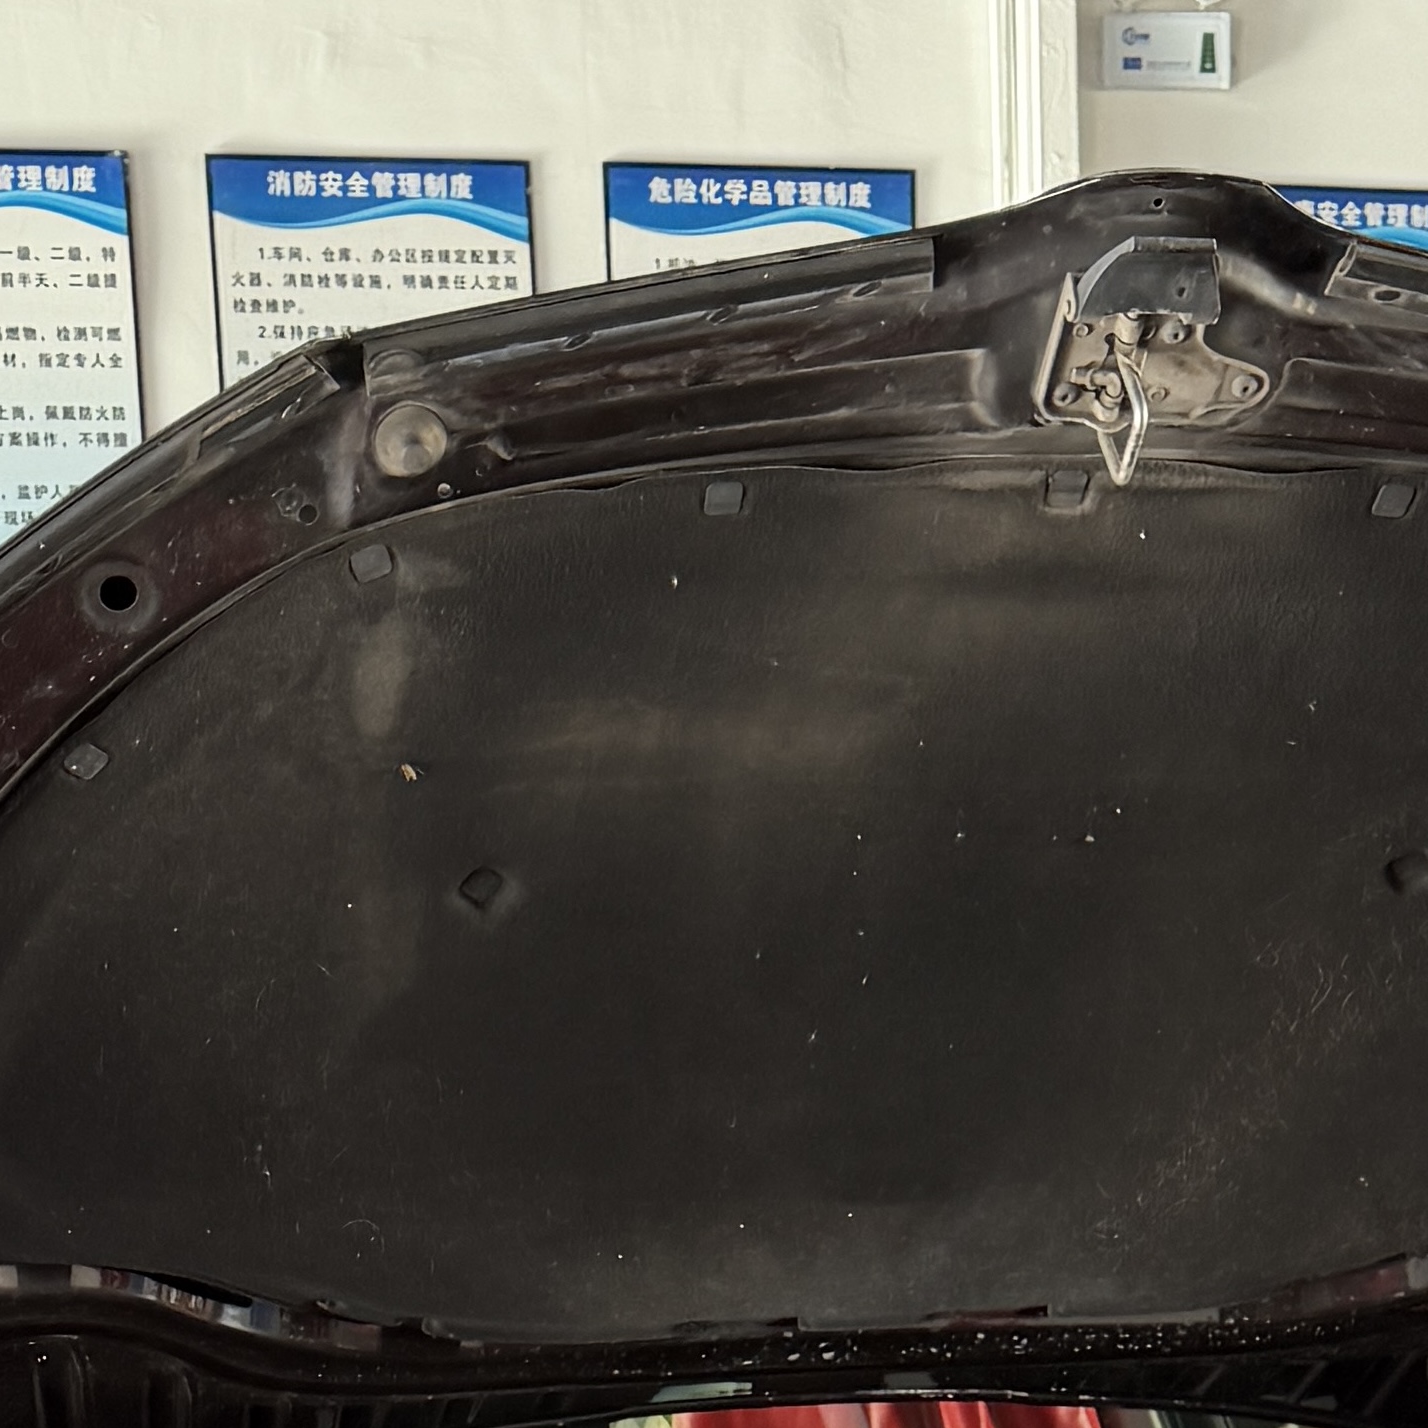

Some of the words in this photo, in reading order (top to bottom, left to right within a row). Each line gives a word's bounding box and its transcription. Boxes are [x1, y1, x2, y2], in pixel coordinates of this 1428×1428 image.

[267, 170, 473, 199] 消防安全管理制度
[648, 176, 871, 208] 危险化学品管理制度
